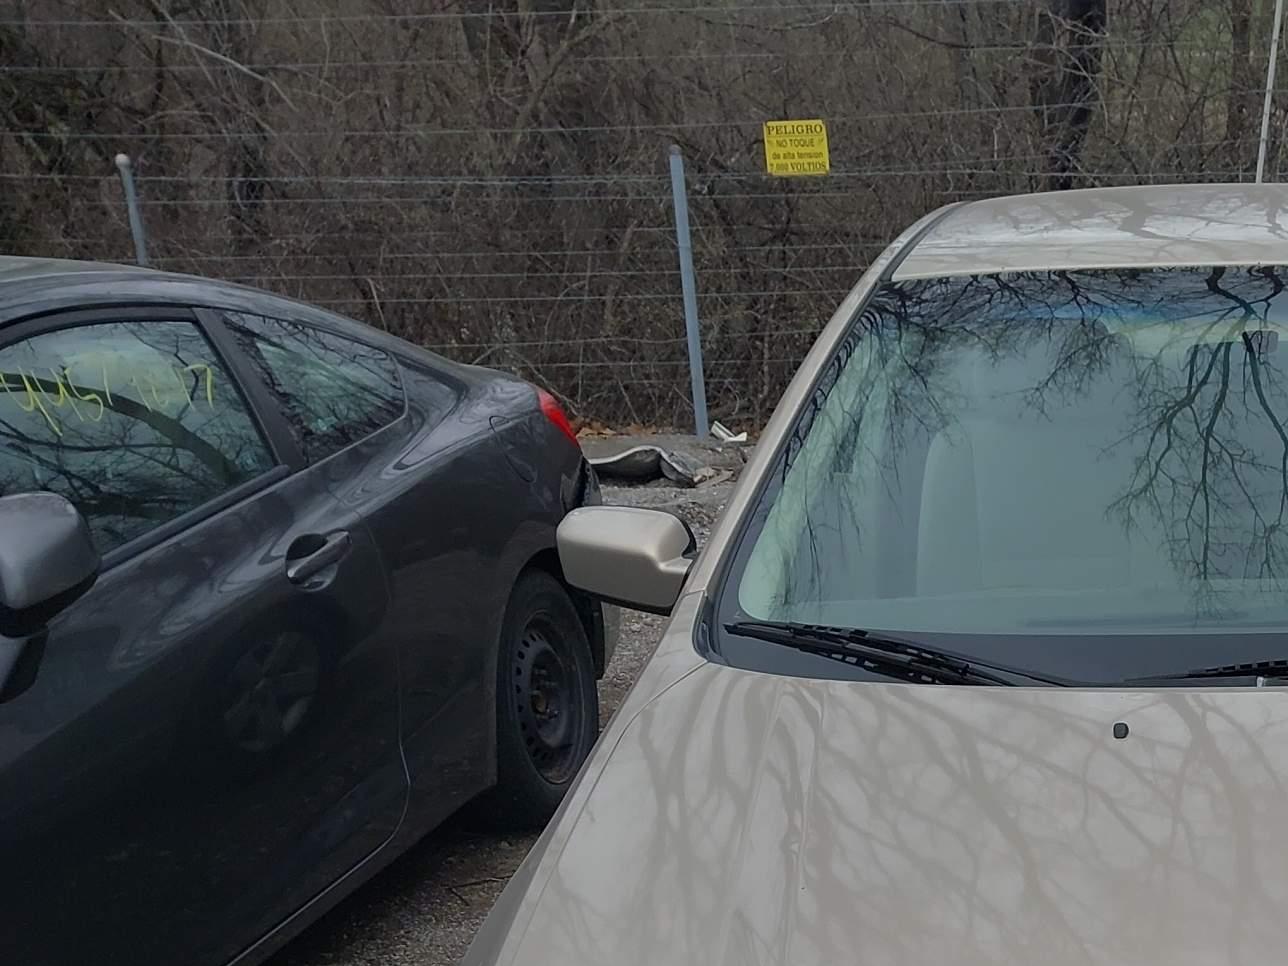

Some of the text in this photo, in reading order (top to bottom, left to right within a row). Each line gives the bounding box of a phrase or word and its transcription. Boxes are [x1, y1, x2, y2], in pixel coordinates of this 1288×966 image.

[767, 124, 823, 135] PELIGRO
[776, 138, 815, 148] NO TOQUE
[790, 161, 826, 172] VOLTIOS
